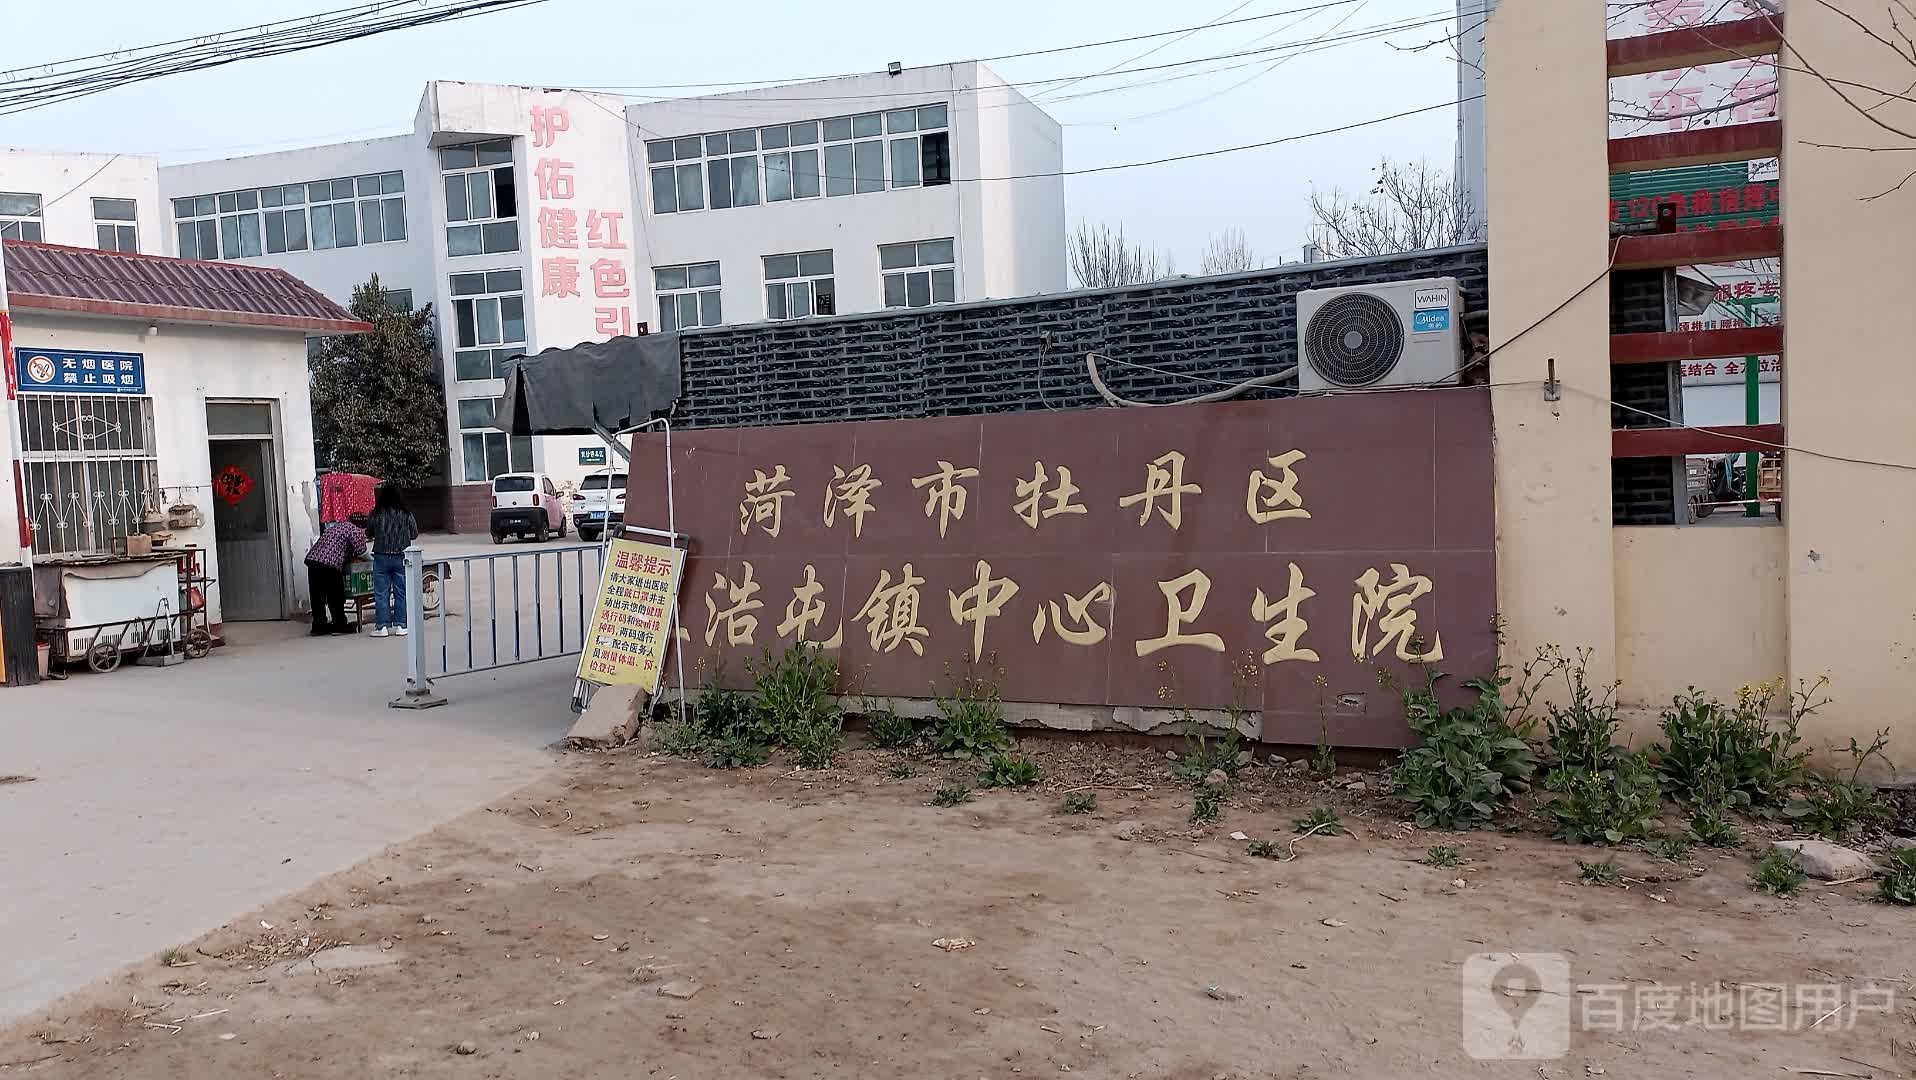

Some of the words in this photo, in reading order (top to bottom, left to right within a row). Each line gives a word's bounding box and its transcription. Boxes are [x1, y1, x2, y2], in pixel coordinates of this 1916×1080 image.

[530, 104, 581, 299] 护佑健康
[585, 209, 631, 337] 红色引
[1417, 294, 1447, 303] WAHIN
[1416, 312, 1445, 325] Midea
[62, 358, 134, 371] 无烟医院
[63, 372, 134, 385] 禁止吸烟
[740, 449, 1312, 538] 菏泽市牡丹区
[615, 550, 672, 576] 温馨提示
[610, 572, 669, 593] 请大家进出医院
[607, 585, 666, 605] 全程戴口罩并主
[604, 597, 664, 618] 动出示您的健康
[672, 559, 1444, 665] 浩屯镇中心卫生院
